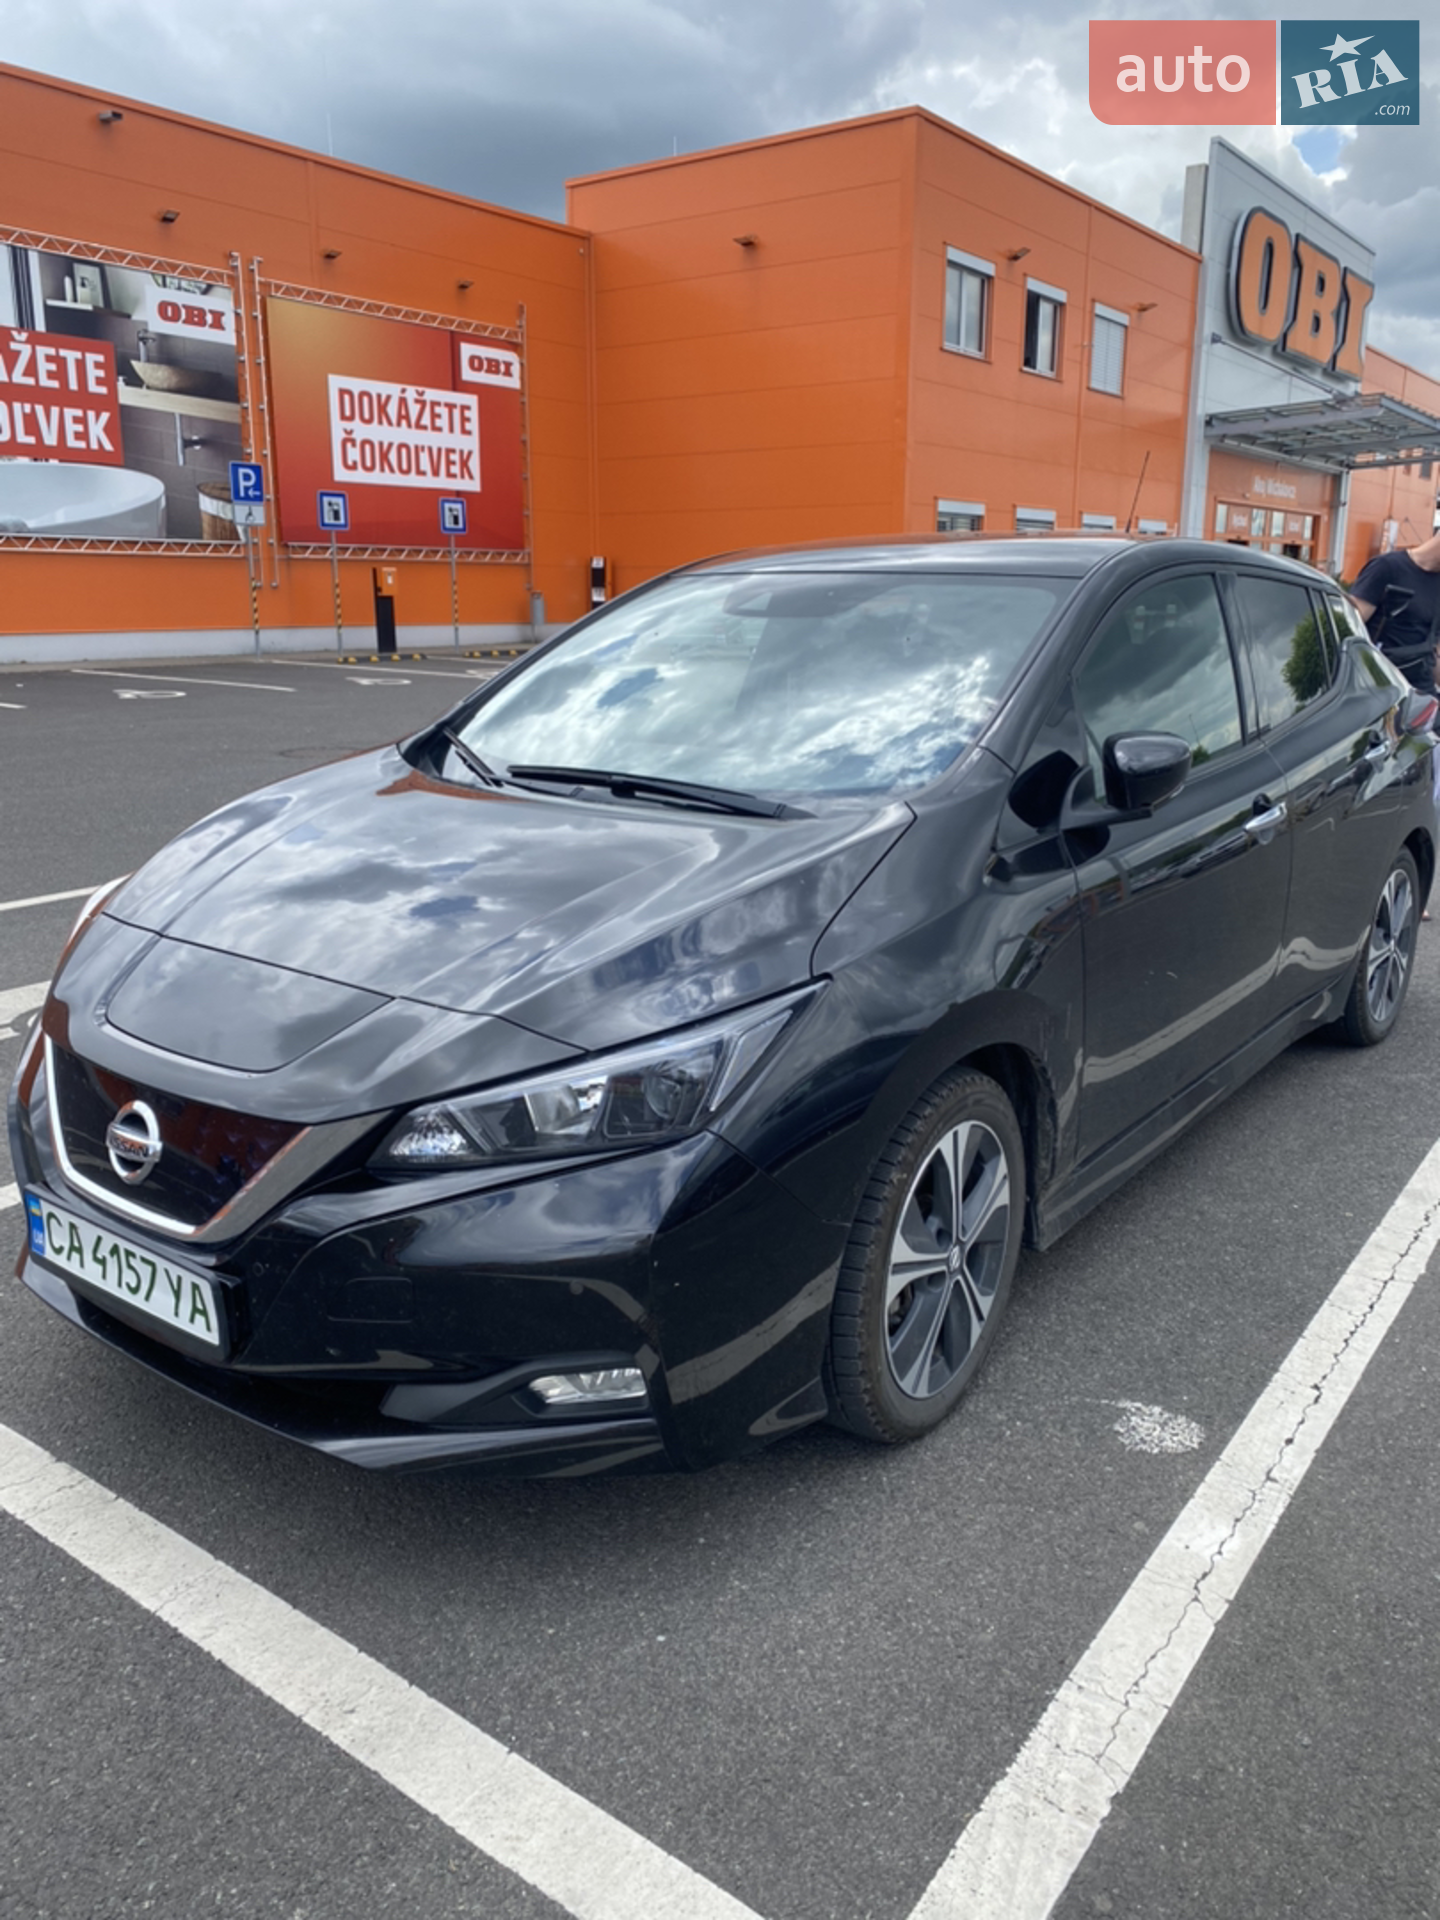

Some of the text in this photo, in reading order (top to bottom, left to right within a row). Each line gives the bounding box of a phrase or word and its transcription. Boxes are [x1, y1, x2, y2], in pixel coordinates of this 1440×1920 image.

[157, 300, 226, 331] OBI
[1230, 206, 1375, 382] OBI
[468, 354, 514, 378] OBI
[338, 387, 472, 436] DOKÁŽETE
[341, 428, 474, 481] ČOKOĽVEK
[238, 467, 256, 498] P
[46, 1212, 212, 1333] CA 4157 YA
